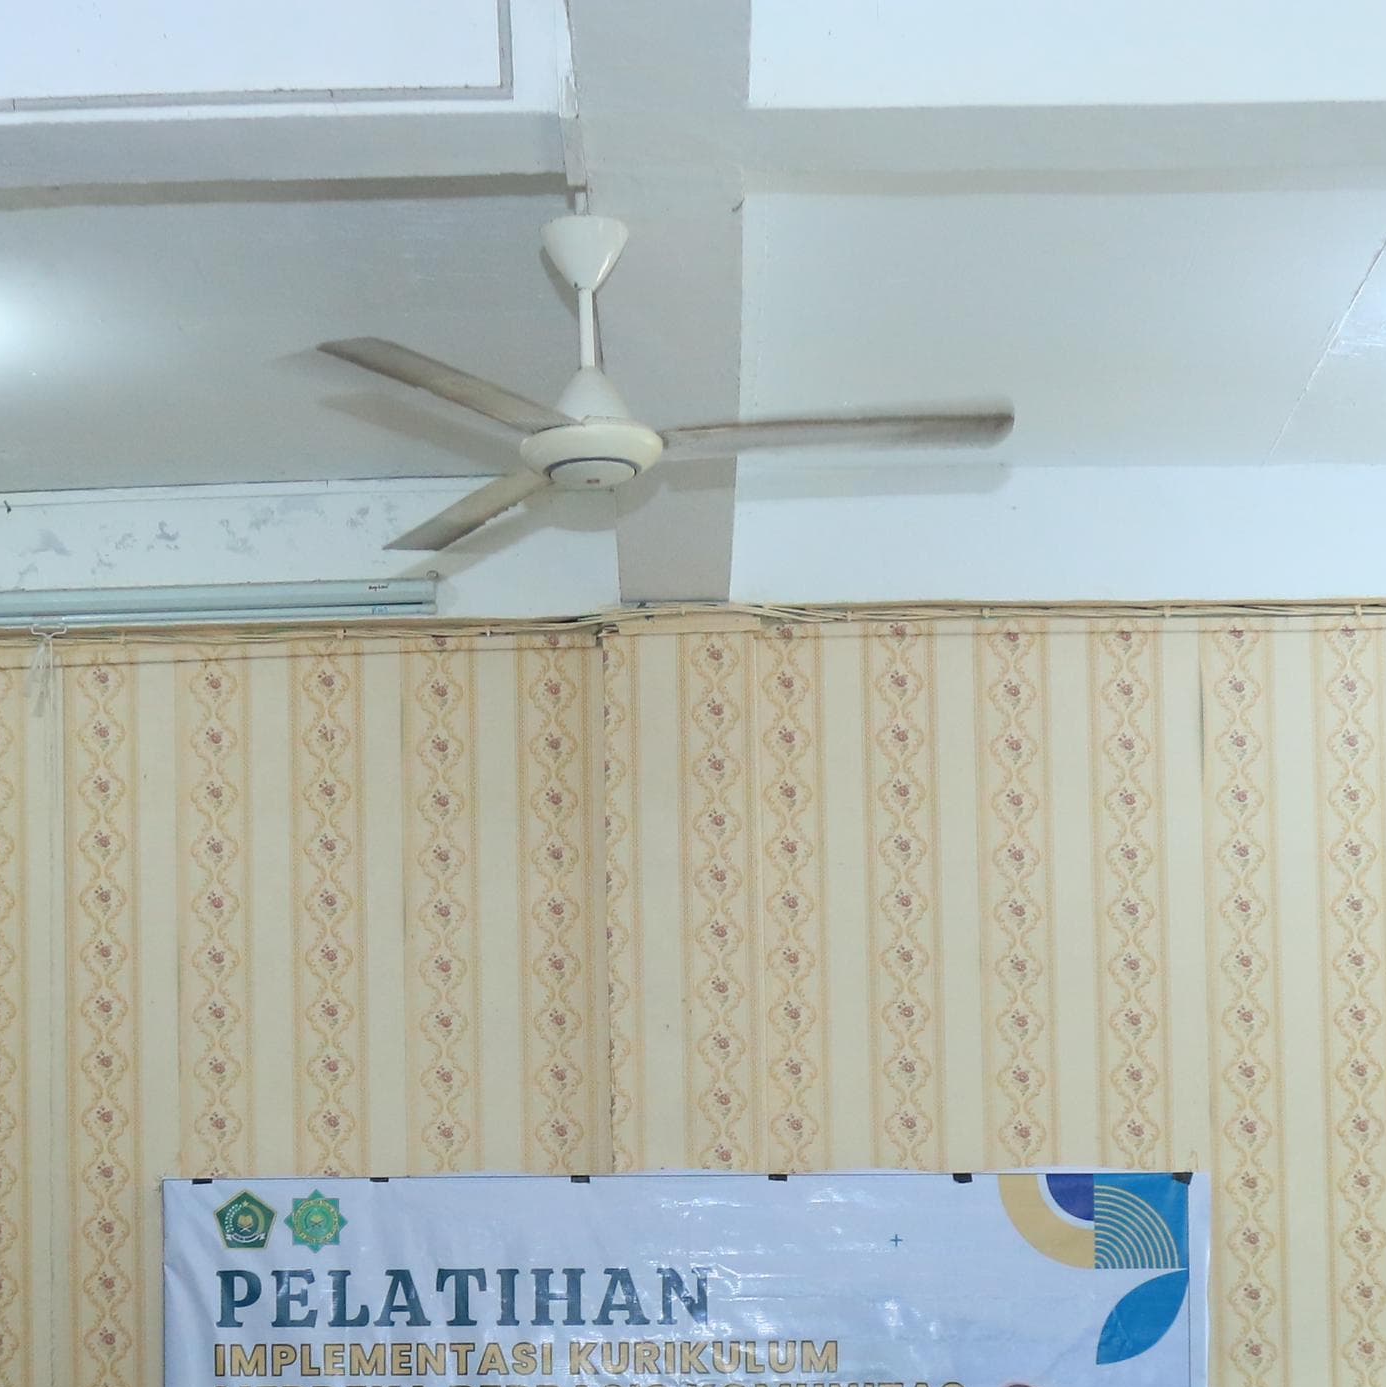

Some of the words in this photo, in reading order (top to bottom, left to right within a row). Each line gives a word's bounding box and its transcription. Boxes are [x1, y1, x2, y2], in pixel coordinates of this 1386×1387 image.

[215, 1267, 712, 1328] PELATIHAN
[214, 1342, 553, 1377] IMPLEMENTASI
[568, 1340, 839, 1375] KURIKULUM
